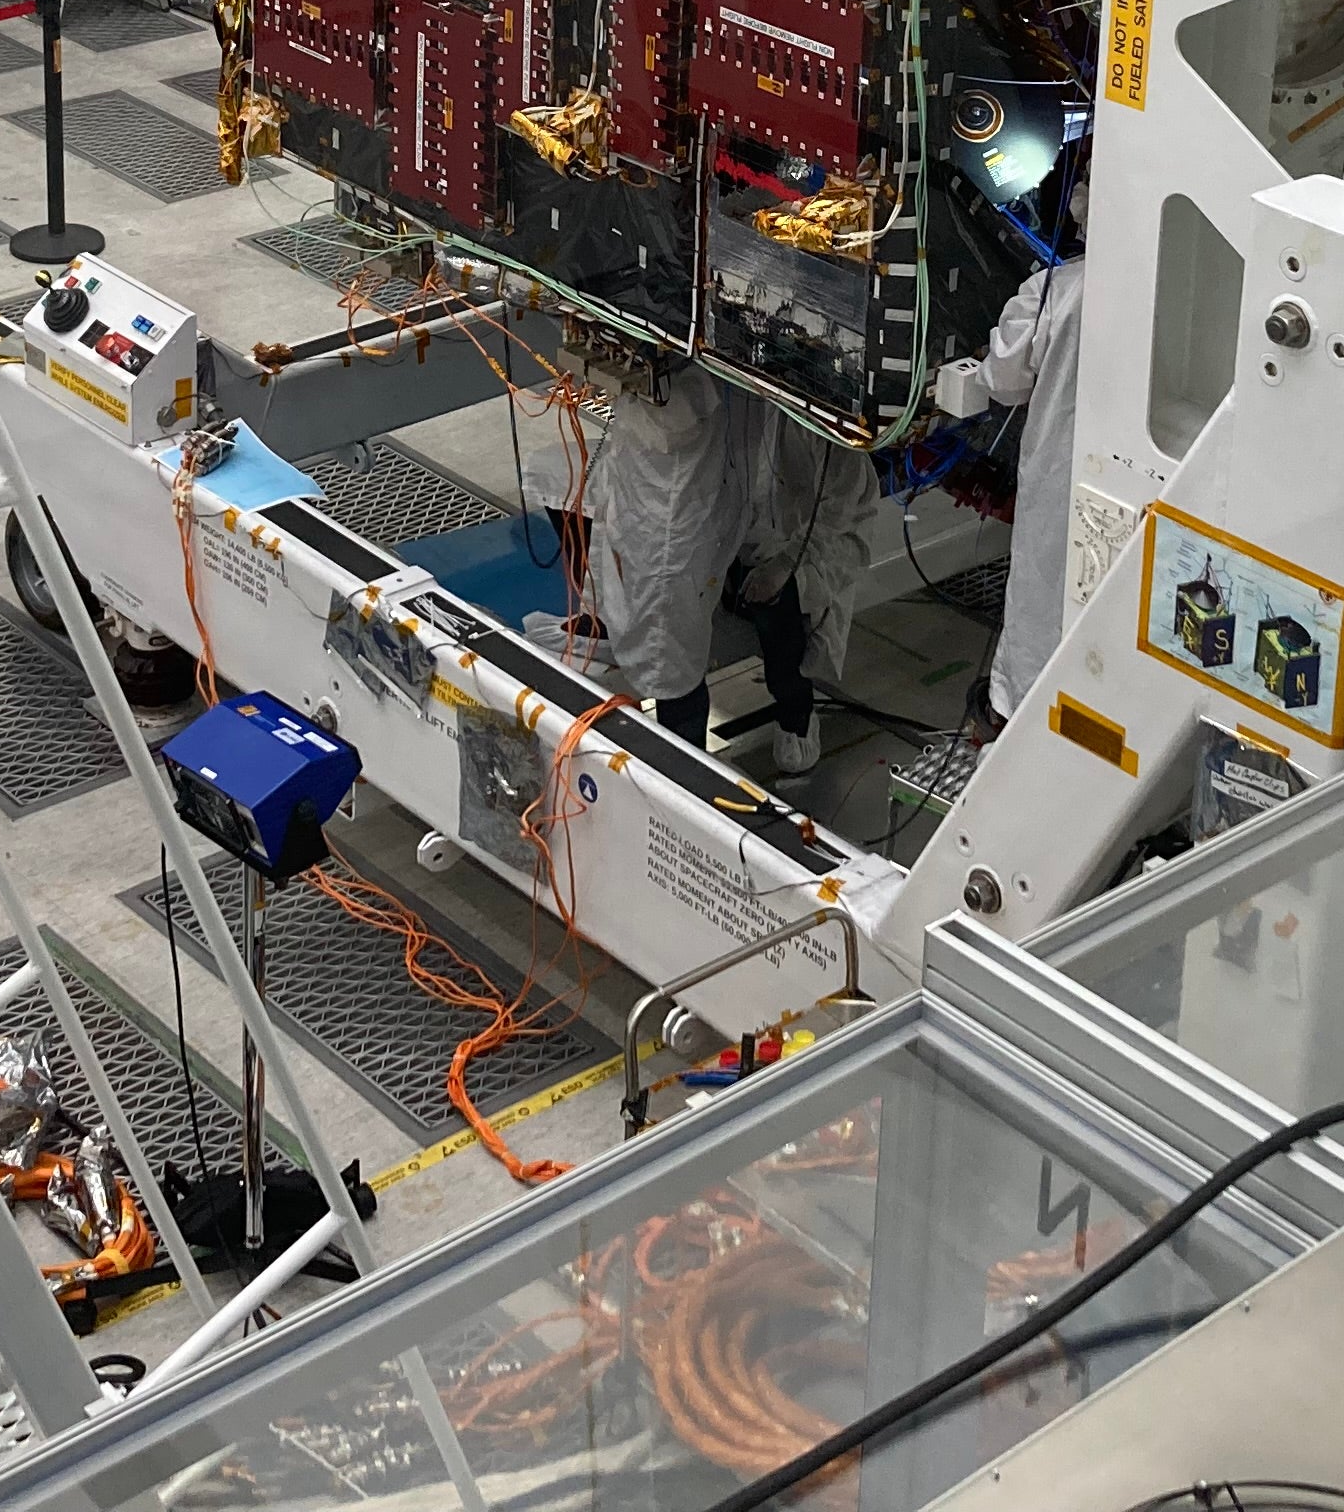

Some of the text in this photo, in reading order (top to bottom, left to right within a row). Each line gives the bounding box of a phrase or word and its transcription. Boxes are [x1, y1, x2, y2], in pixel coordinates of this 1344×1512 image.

[721, 9, 833, 57] NON FLIGHT REMOVE BEFORE FLIGHT
[1114, 19, 1128, 54] NOT
[1112, 63, 1124, 89] DO
[1129, 36, 1144, 101] FUELED
[106, 394, 127, 412] CLEAR
[1214, 629, 1230, 651] S
[1296, 673, 1306, 691] N
[425, 711, 445, 732] LIFT
[649, 815, 678, 841] RATED
[678, 837, 704, 859] LOAD
[729, 868, 741, 884] LB
[647, 856, 676, 882] RATED
[677, 877, 715, 910] MOMENT
[717, 901, 748, 928] ABOUT
[647, 870, 669, 890] AXIS:
[694, 903, 720, 928] FT-LB
[648, 829, 677, 854] RATED
[812, 938, 837, 962] IN-LB
[648, 842, 678, 865] ABOUT
[679, 859, 738, 909] SPACECRAFT
[740, 903, 765, 927] ZERO
[802, 945, 828, 971] AXIS)
